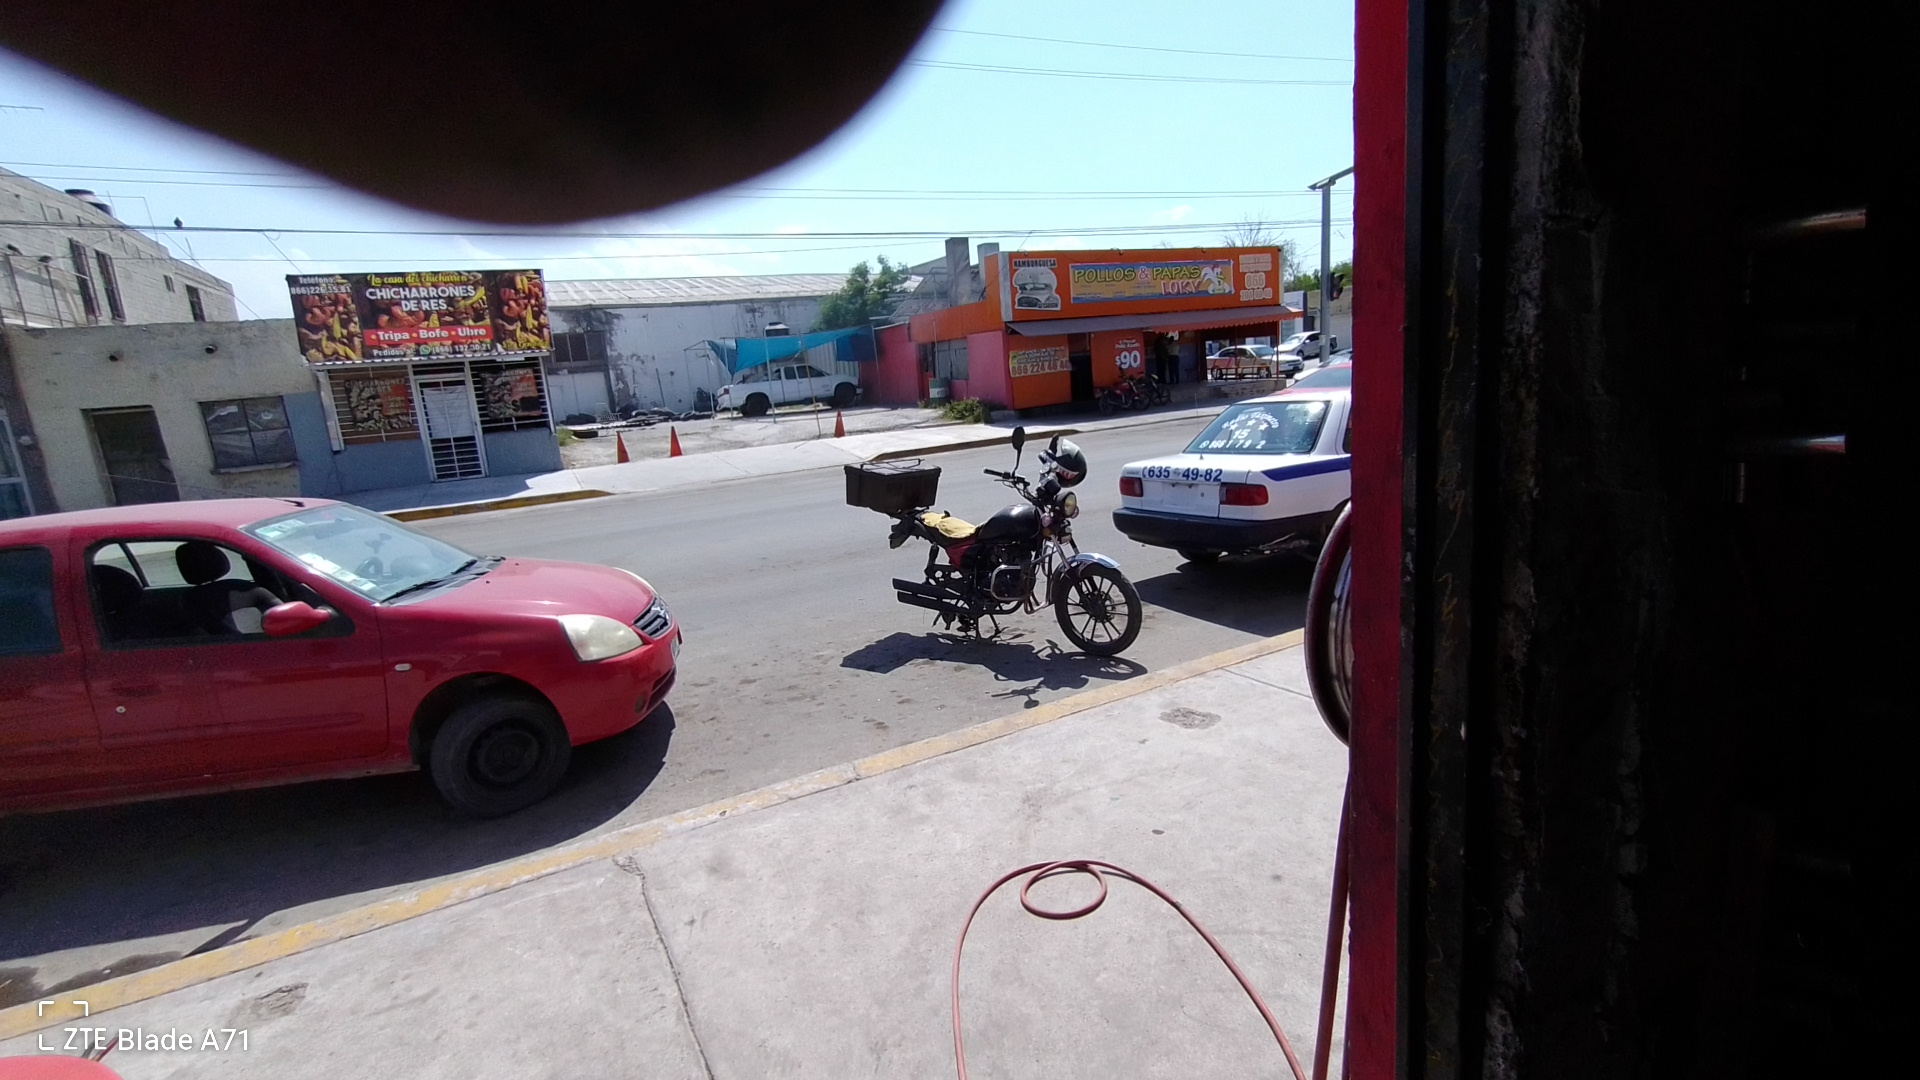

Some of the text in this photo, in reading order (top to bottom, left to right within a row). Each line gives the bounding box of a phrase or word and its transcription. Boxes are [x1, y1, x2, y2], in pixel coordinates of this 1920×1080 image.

[1013, 259, 1057, 268] HAMBURGUESA
[367, 274, 382, 287] La
[384, 275, 404, 285] casa
[1074, 265, 1201, 284] POLLOS & PAPAS
[366, 286, 476, 300] CHICHARRONES
[1161, 280, 1201, 296] LOKY
[402, 299, 448, 312] DE RES
[377, 327, 487, 342] Tripa Bofe Ubre
[1115, 350, 1141, 369] $90
[1233, 429, 1251, 439] 15
[1181, 467, 1223, 482] 49-82
